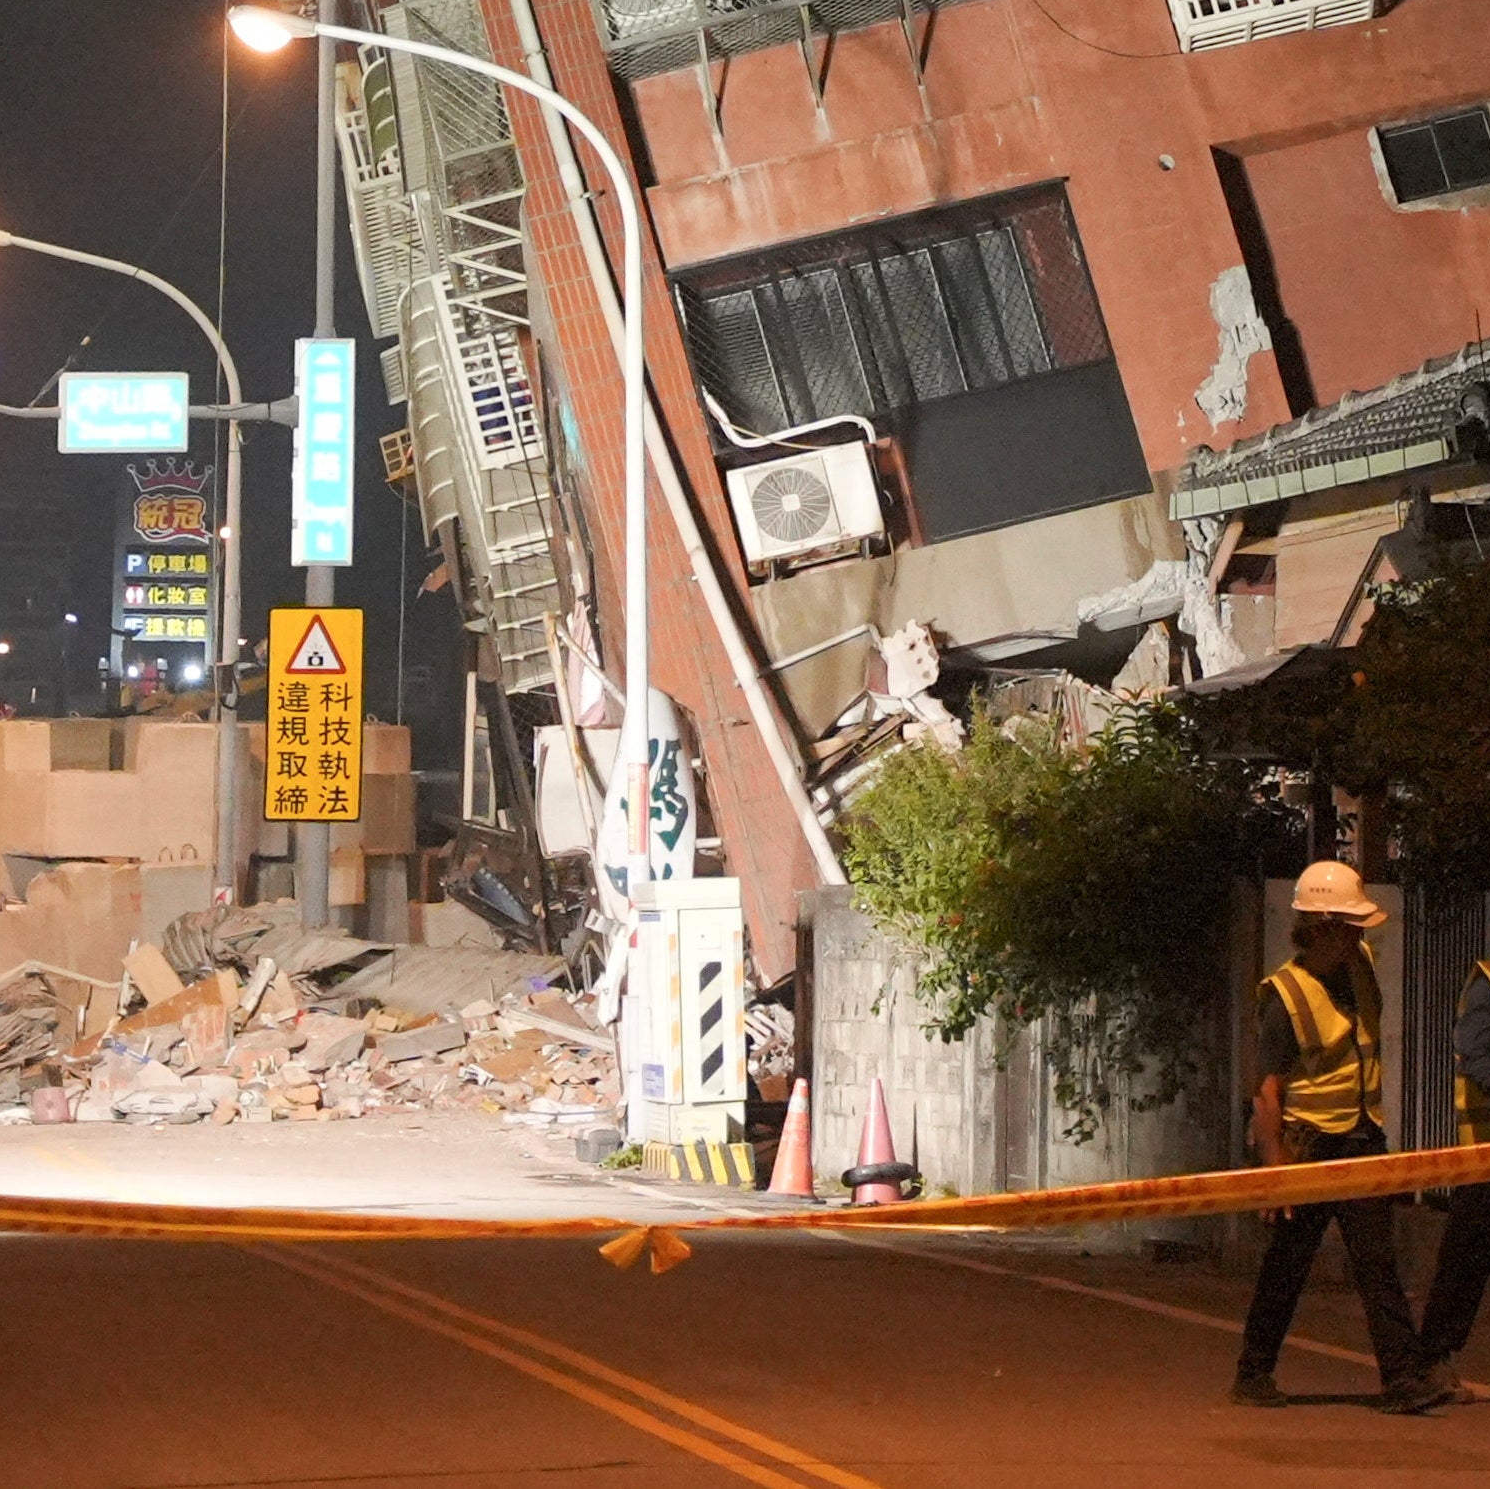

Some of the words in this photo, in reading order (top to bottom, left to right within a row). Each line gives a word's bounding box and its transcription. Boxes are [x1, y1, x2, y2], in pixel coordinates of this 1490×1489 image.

[78, 382, 172, 415] 中山
[138, 497, 203, 530] 統冠
[148, 554, 207, 573] 停車場
[274, 681, 311, 815] 違規取締
[318, 682, 354, 815] 科技執法
